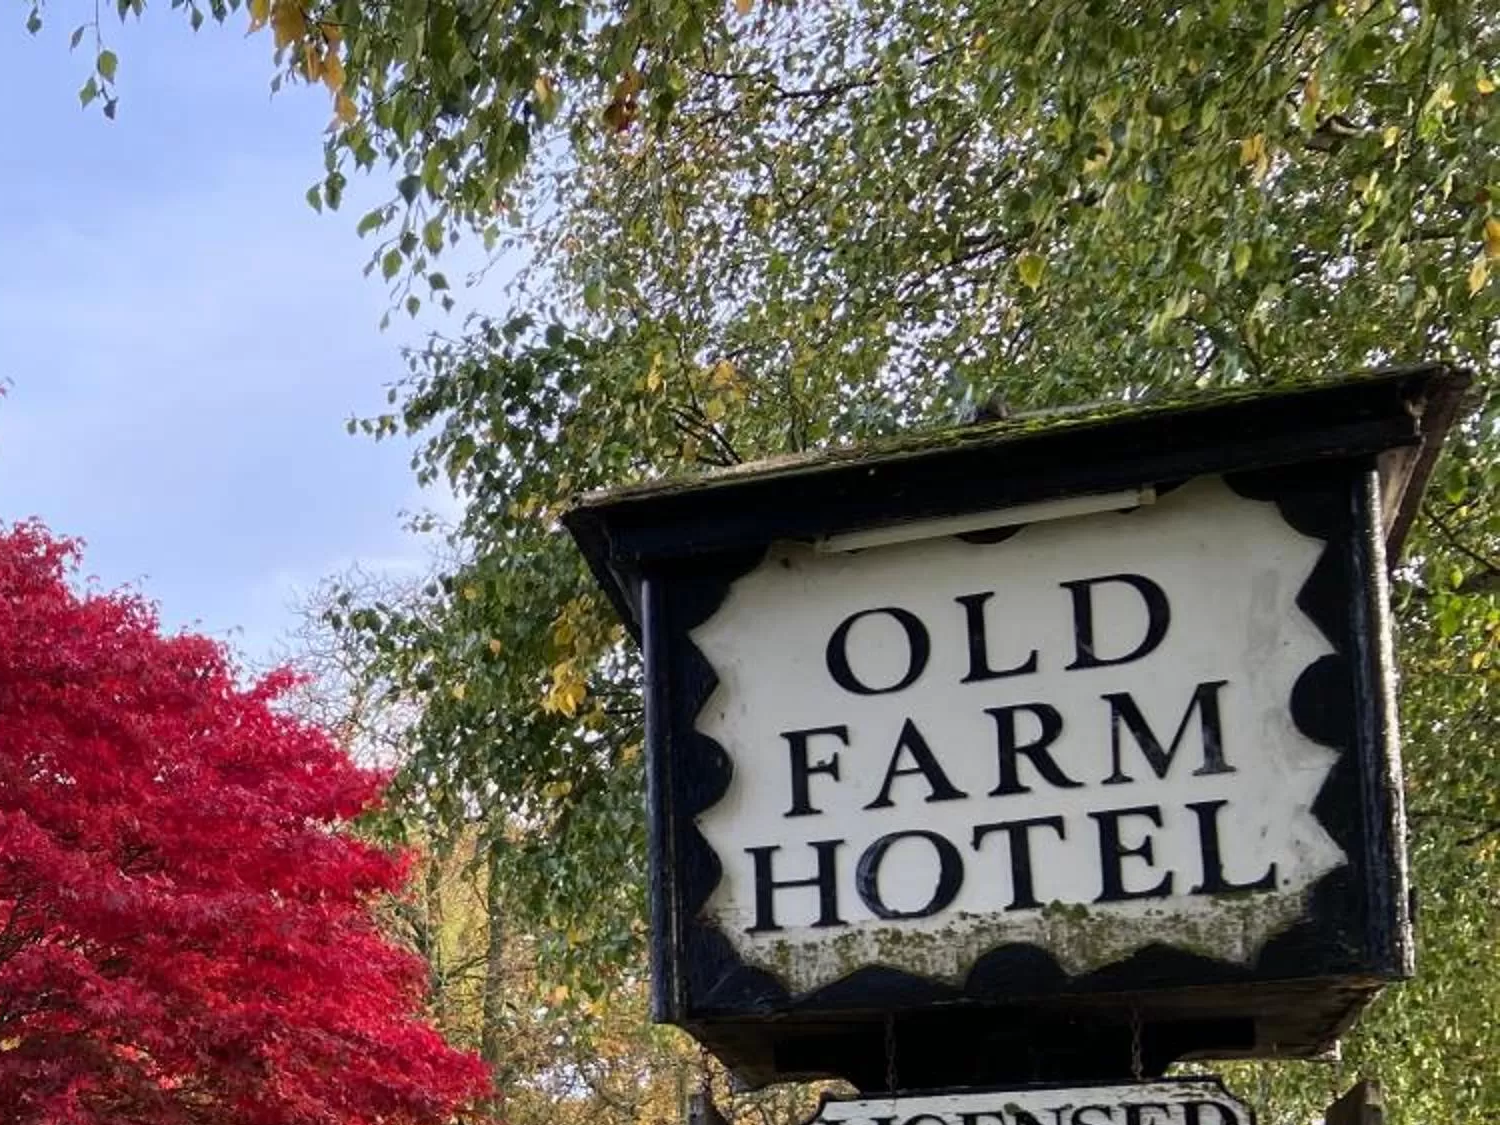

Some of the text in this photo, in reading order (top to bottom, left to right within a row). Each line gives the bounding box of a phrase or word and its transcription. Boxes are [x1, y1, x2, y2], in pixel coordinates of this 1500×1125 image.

[825, 573, 1172, 696] OLD
[781, 680, 1237, 818] FARM
[743, 799, 1278, 934] HOTEL
